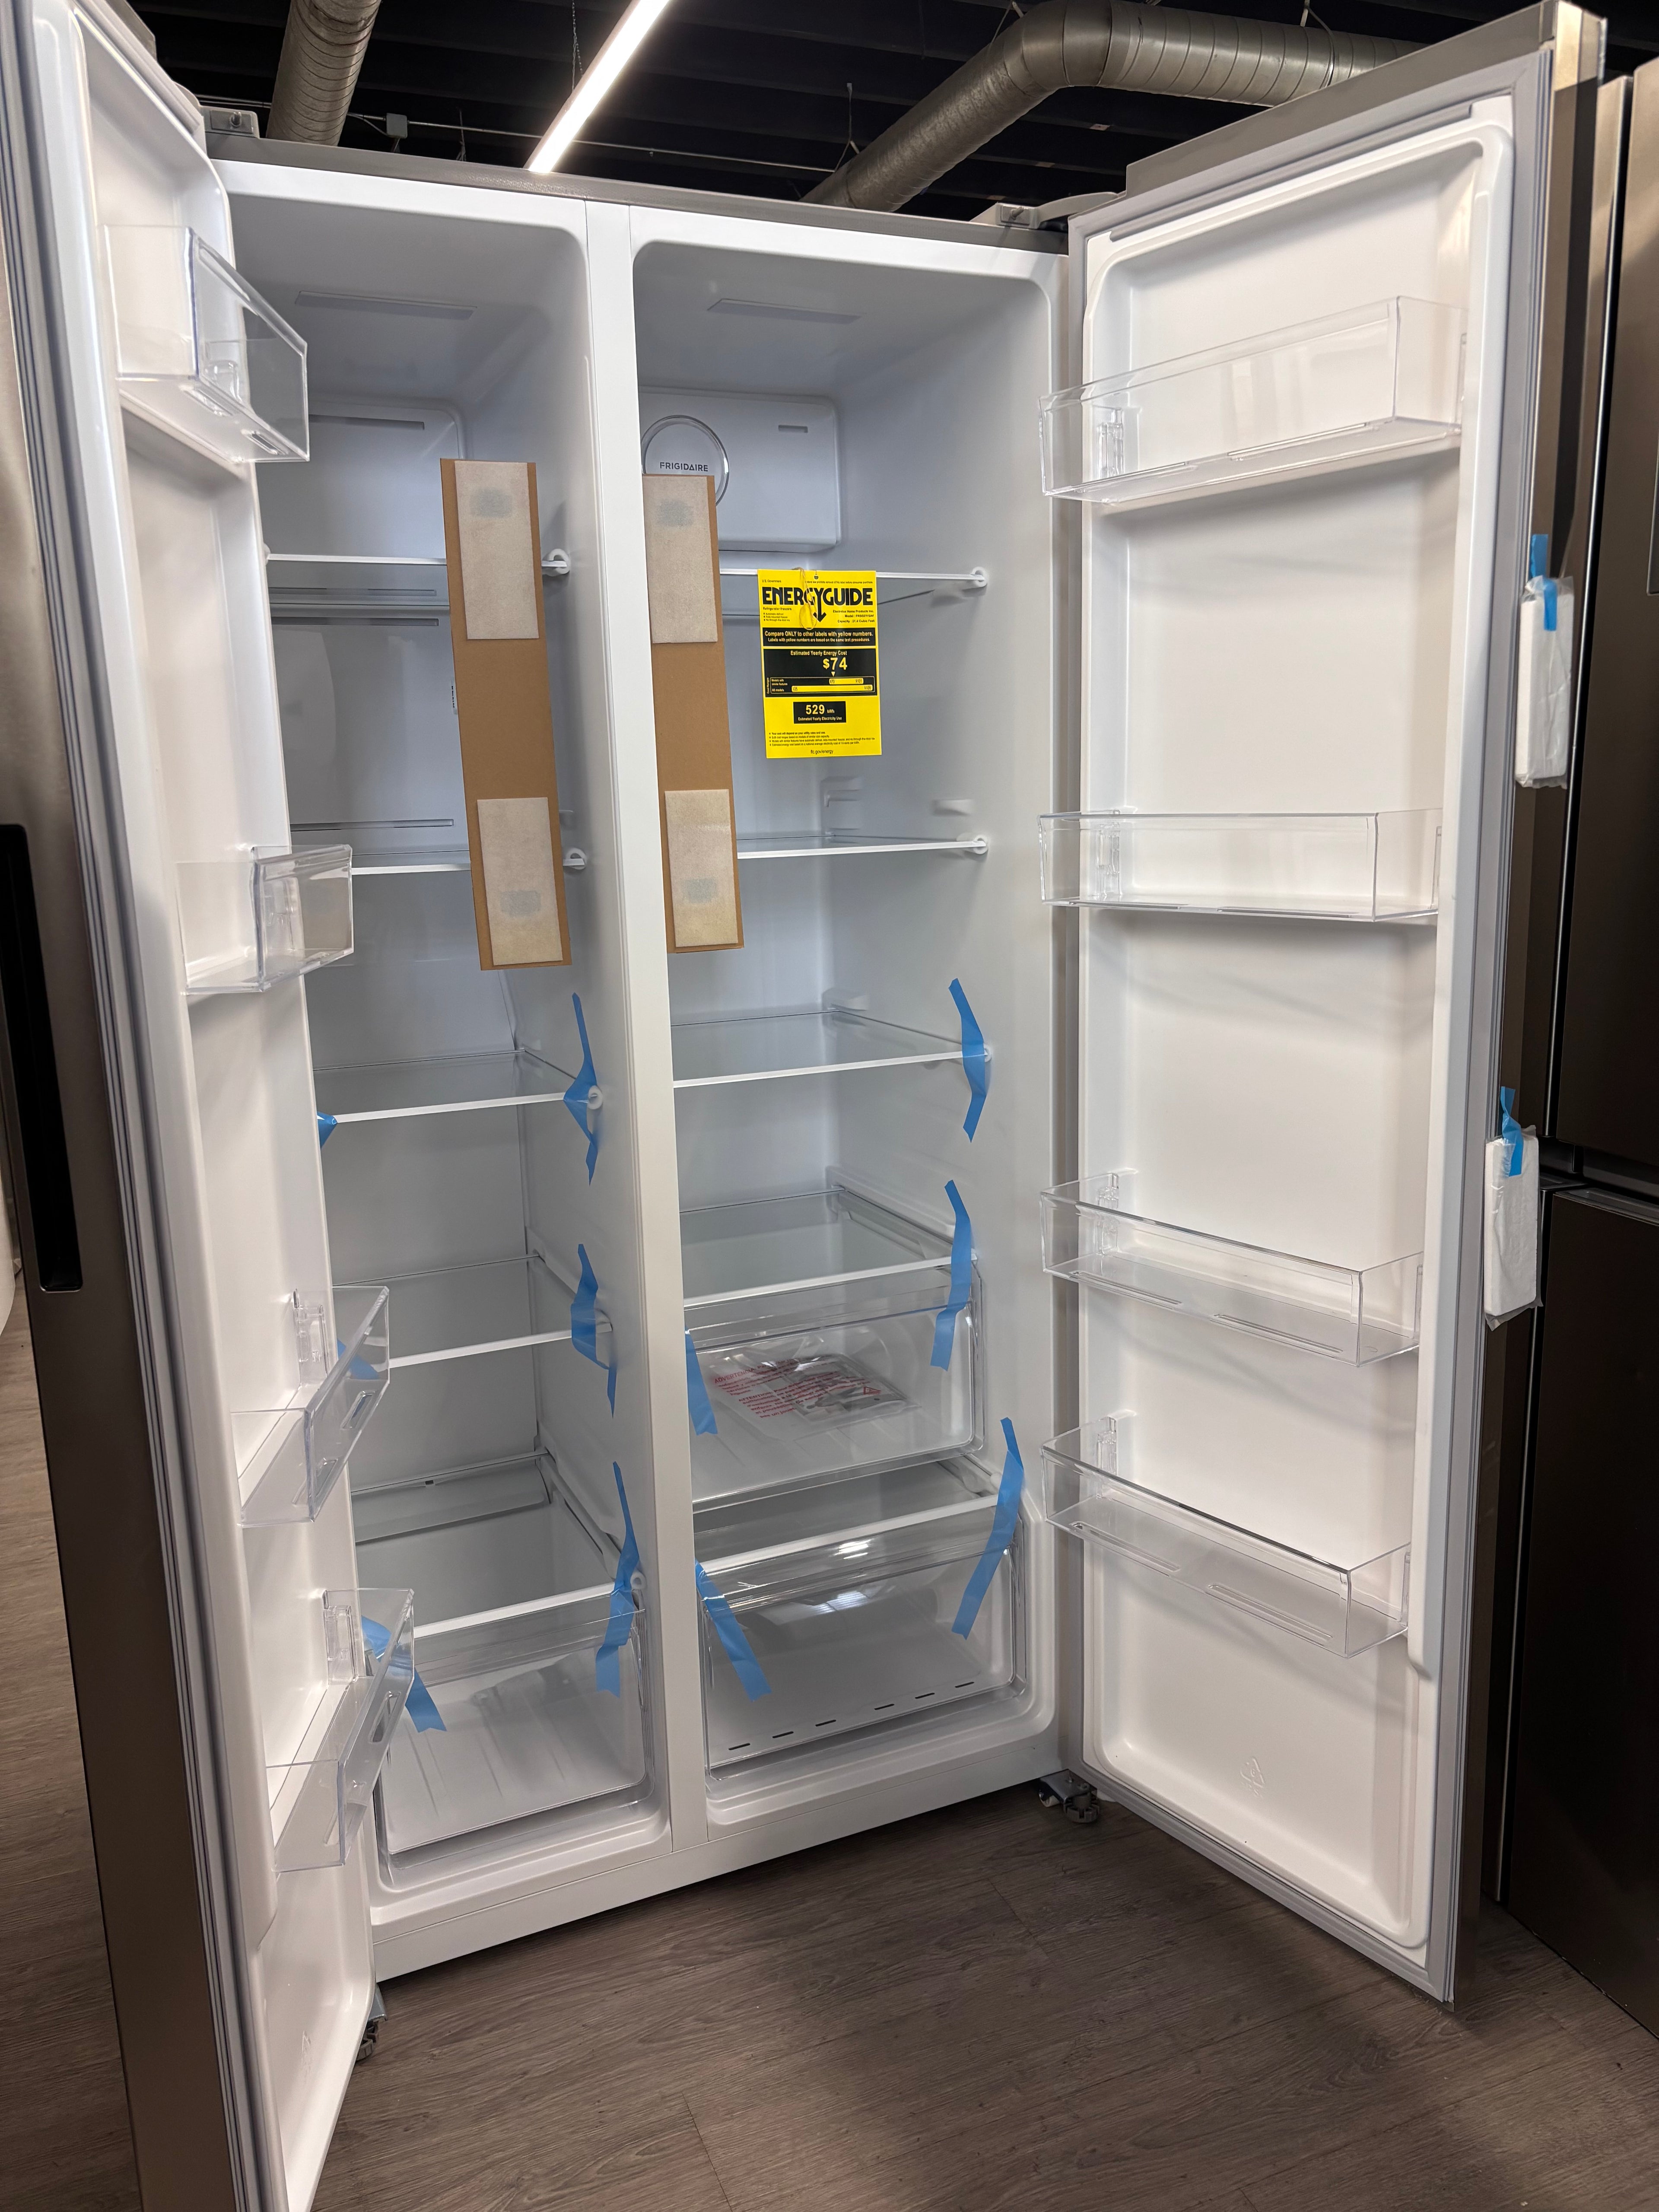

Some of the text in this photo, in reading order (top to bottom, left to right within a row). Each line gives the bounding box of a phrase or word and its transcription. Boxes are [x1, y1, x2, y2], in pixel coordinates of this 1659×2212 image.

[660, 462, 708, 471] FRIGIDAIRE
[762, 586, 873, 606] ENERGYGUIDE
[823, 657, 847, 670] $74
[806, 704, 825, 715] 529
